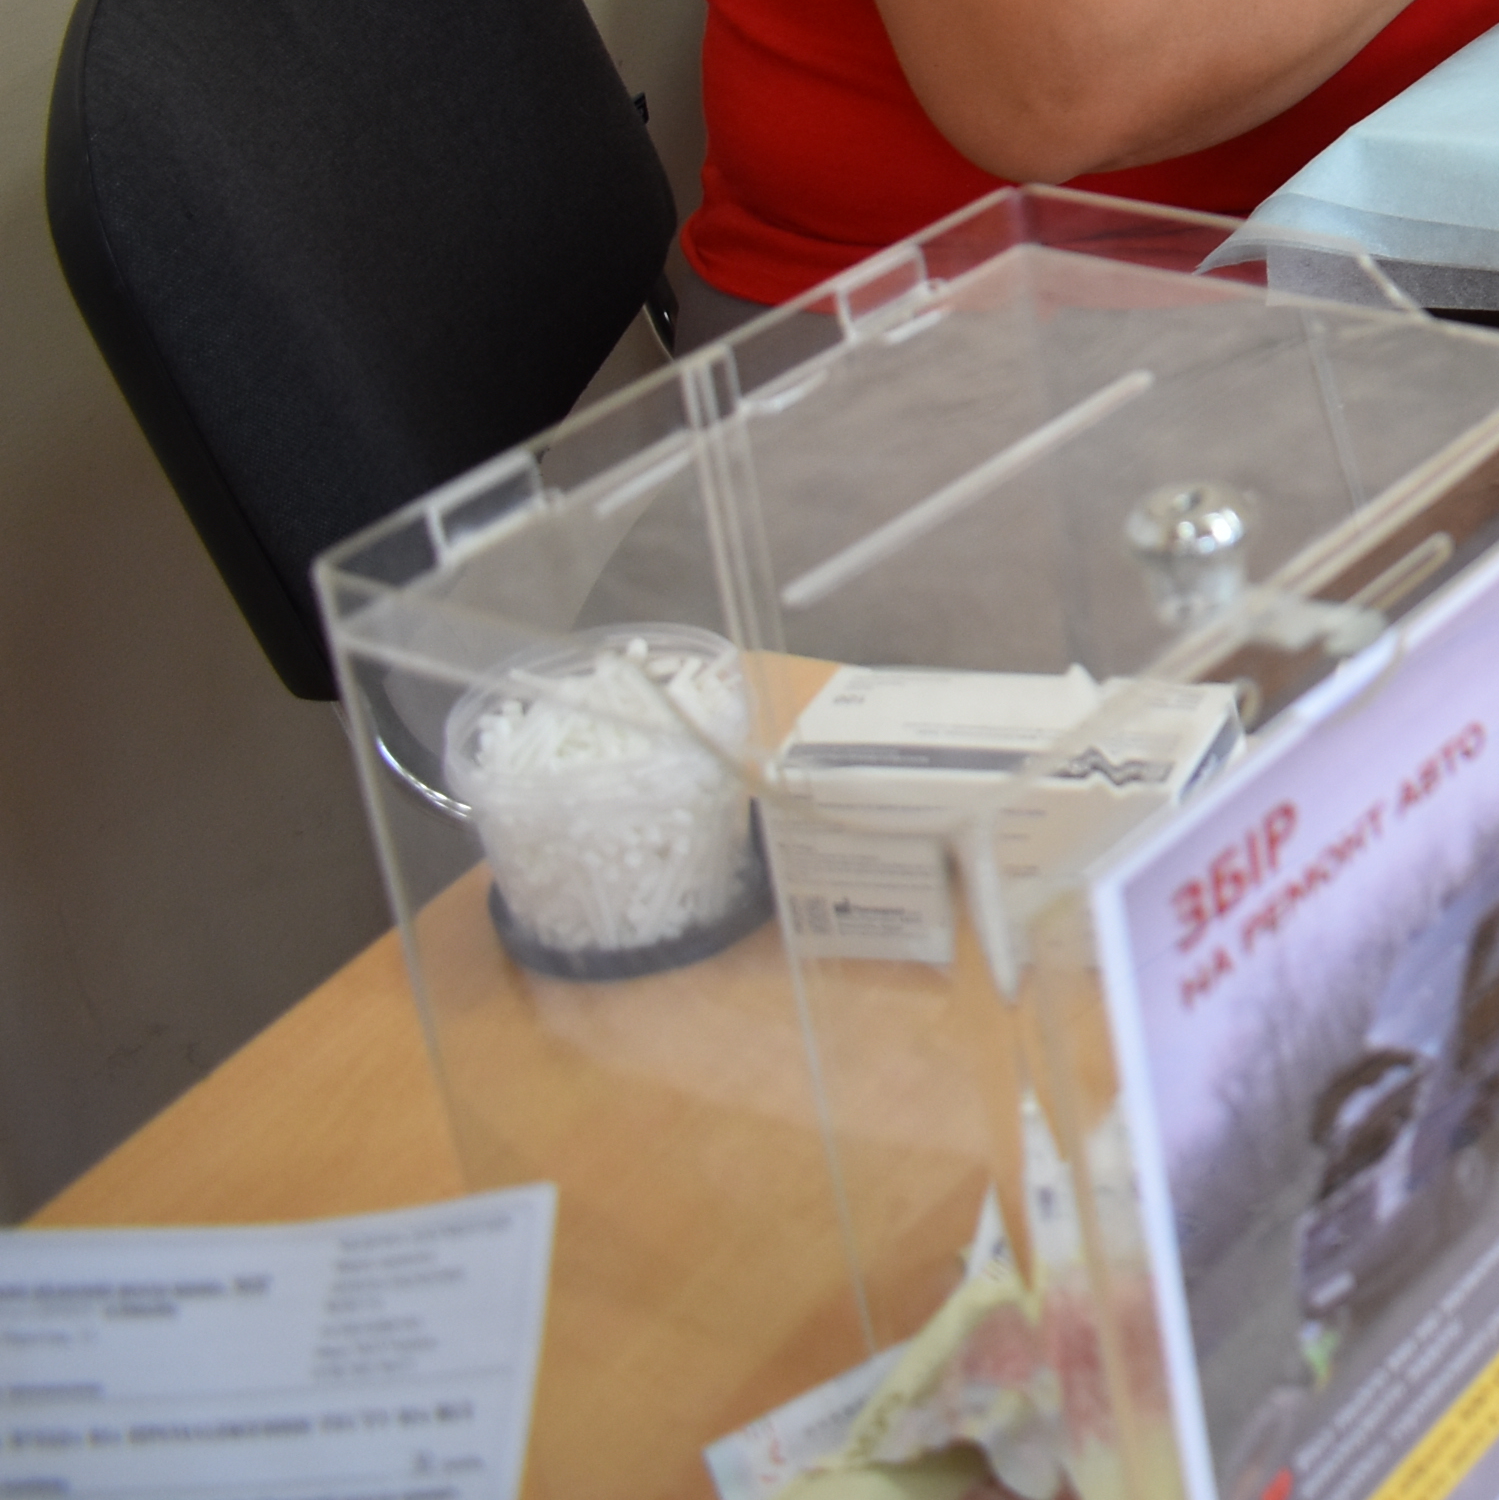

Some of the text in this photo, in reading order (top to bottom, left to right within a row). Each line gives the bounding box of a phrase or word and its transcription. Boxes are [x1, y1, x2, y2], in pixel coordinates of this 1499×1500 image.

[1170, 800, 1298, 954] ЗБІР
[1239, 797, 1385, 954] РЕМОНТ
[1395, 721, 1488, 820] АВТО
